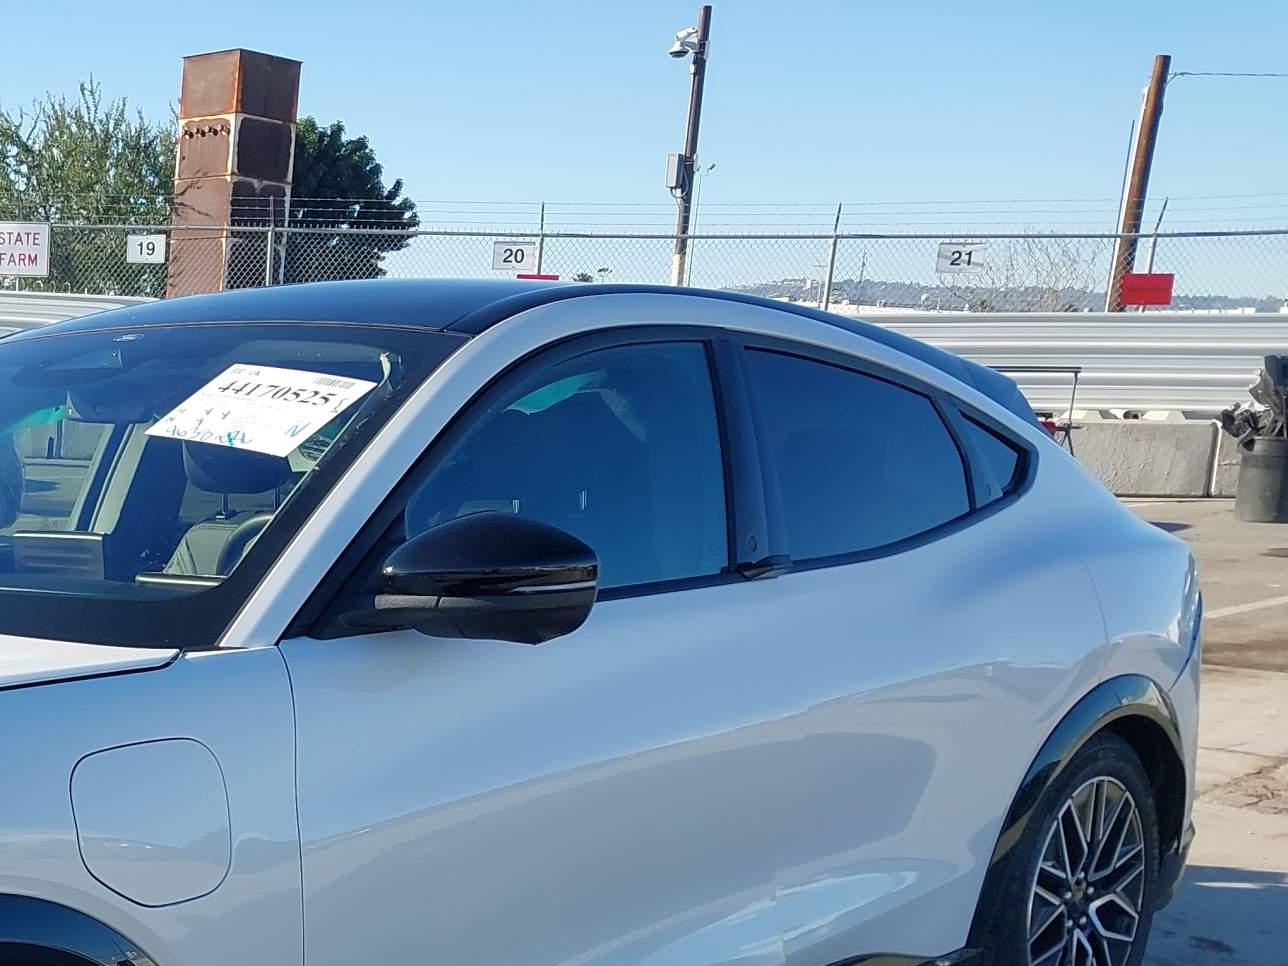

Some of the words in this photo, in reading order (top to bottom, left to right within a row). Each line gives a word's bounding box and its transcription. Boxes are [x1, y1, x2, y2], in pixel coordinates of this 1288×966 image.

[137, 241, 155, 256] 19
[502, 248, 525, 263] 20
[949, 250, 973, 266] 21
[218, 380, 337, 406] 44170525
